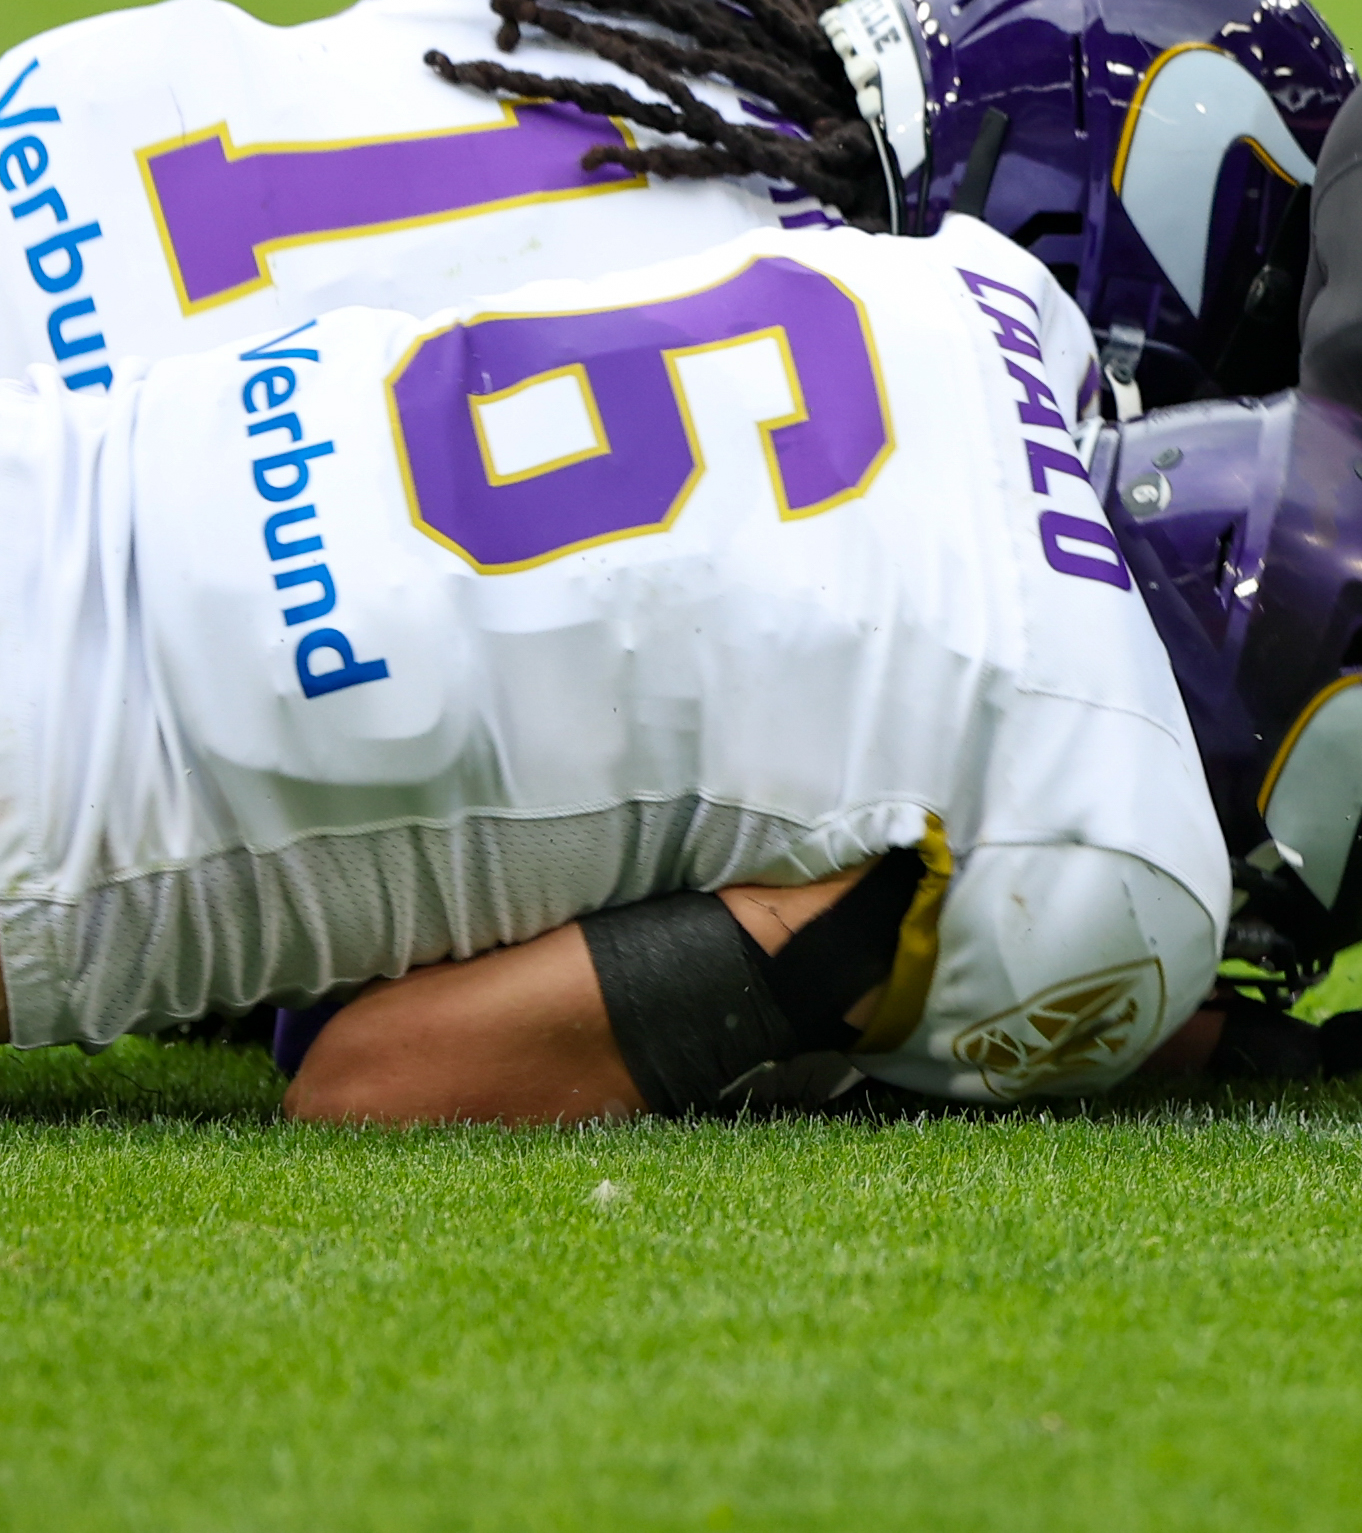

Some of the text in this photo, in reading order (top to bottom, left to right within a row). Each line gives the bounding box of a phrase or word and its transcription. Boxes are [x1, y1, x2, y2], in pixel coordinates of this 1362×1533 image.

[134, 97, 648, 317] 1
[238, 320, 390, 700] Verbund
[384, 254, 896, 576] 6
